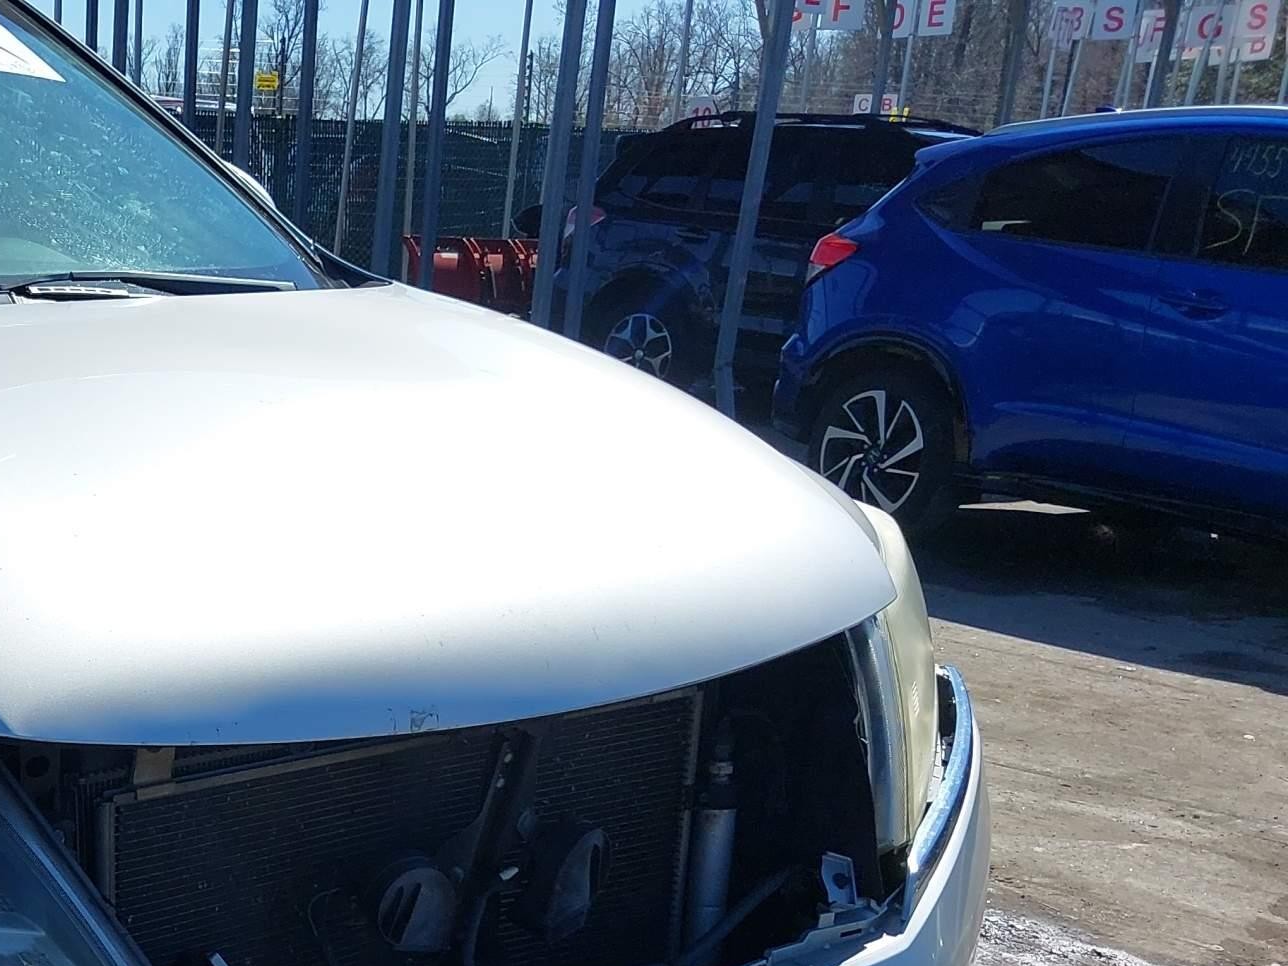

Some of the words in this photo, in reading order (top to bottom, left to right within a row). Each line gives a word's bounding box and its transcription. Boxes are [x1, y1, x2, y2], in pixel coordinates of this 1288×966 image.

[927, 0, 947, 27] E
[1103, 6, 1125, 32] S
[1247, 4, 1268, 30] S
[858, 102, 869, 112] C
[881, 102, 893, 112] B
